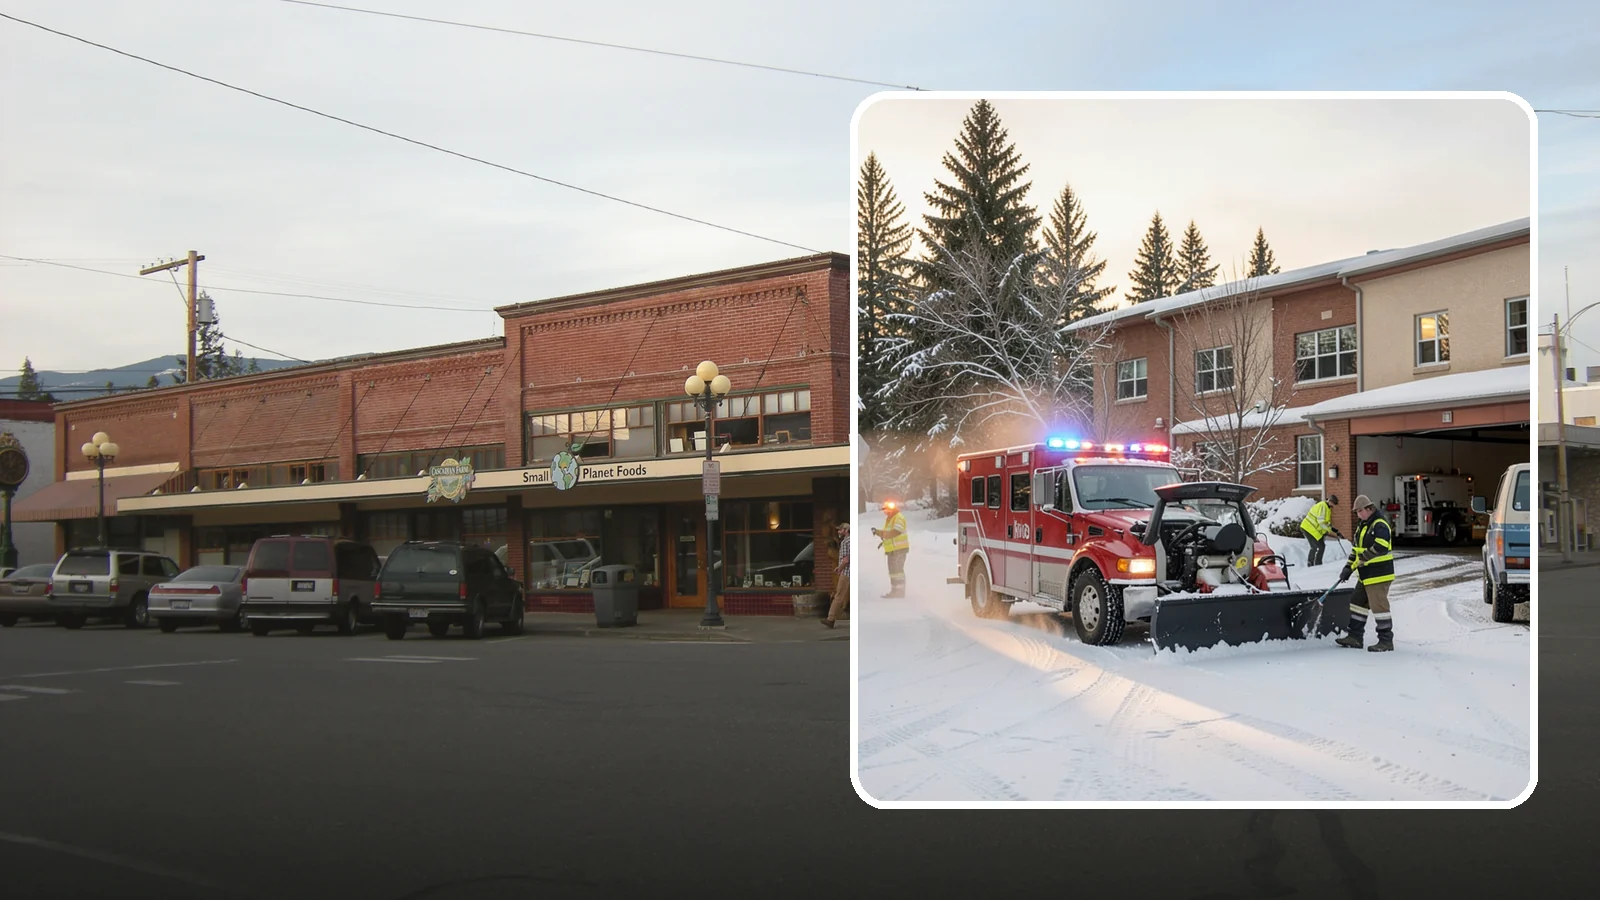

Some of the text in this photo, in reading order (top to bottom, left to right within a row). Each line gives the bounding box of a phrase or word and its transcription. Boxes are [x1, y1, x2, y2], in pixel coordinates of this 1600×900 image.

[523, 465, 647, 483] Small Planet Foods
